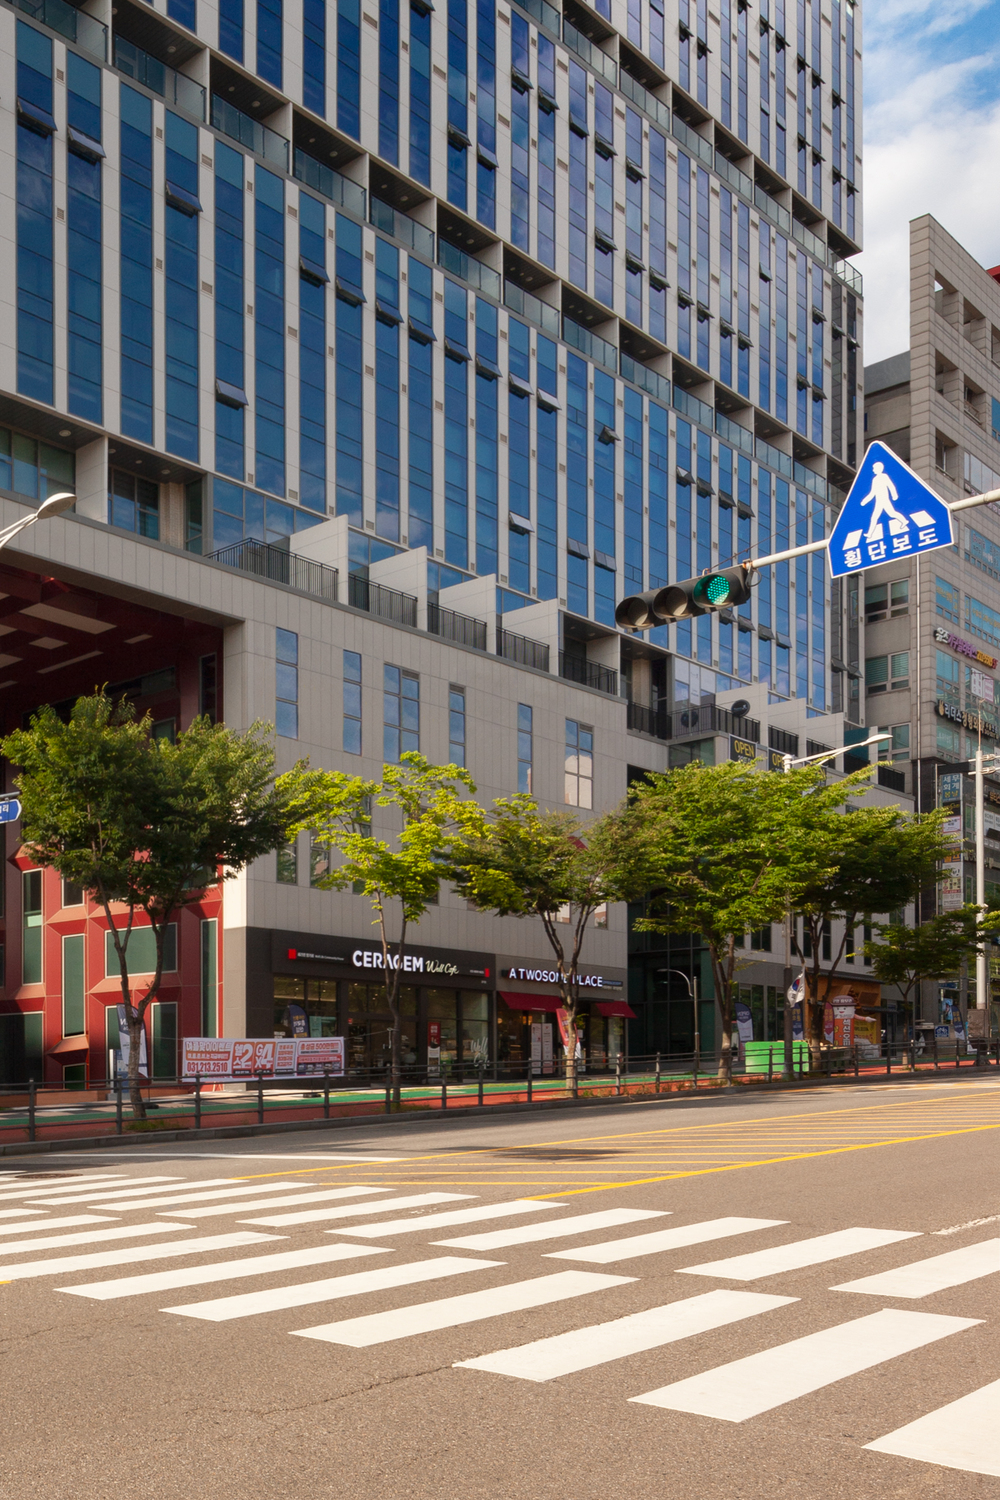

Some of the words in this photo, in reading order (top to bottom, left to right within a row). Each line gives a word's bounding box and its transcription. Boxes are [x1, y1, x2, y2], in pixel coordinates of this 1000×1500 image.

[843, 528, 939, 569] 횡단보도
[734, 740, 755, 758] OPEN
[509, 968, 517, 979] A
[187, 1061, 228, 1073] 031.213.2510
